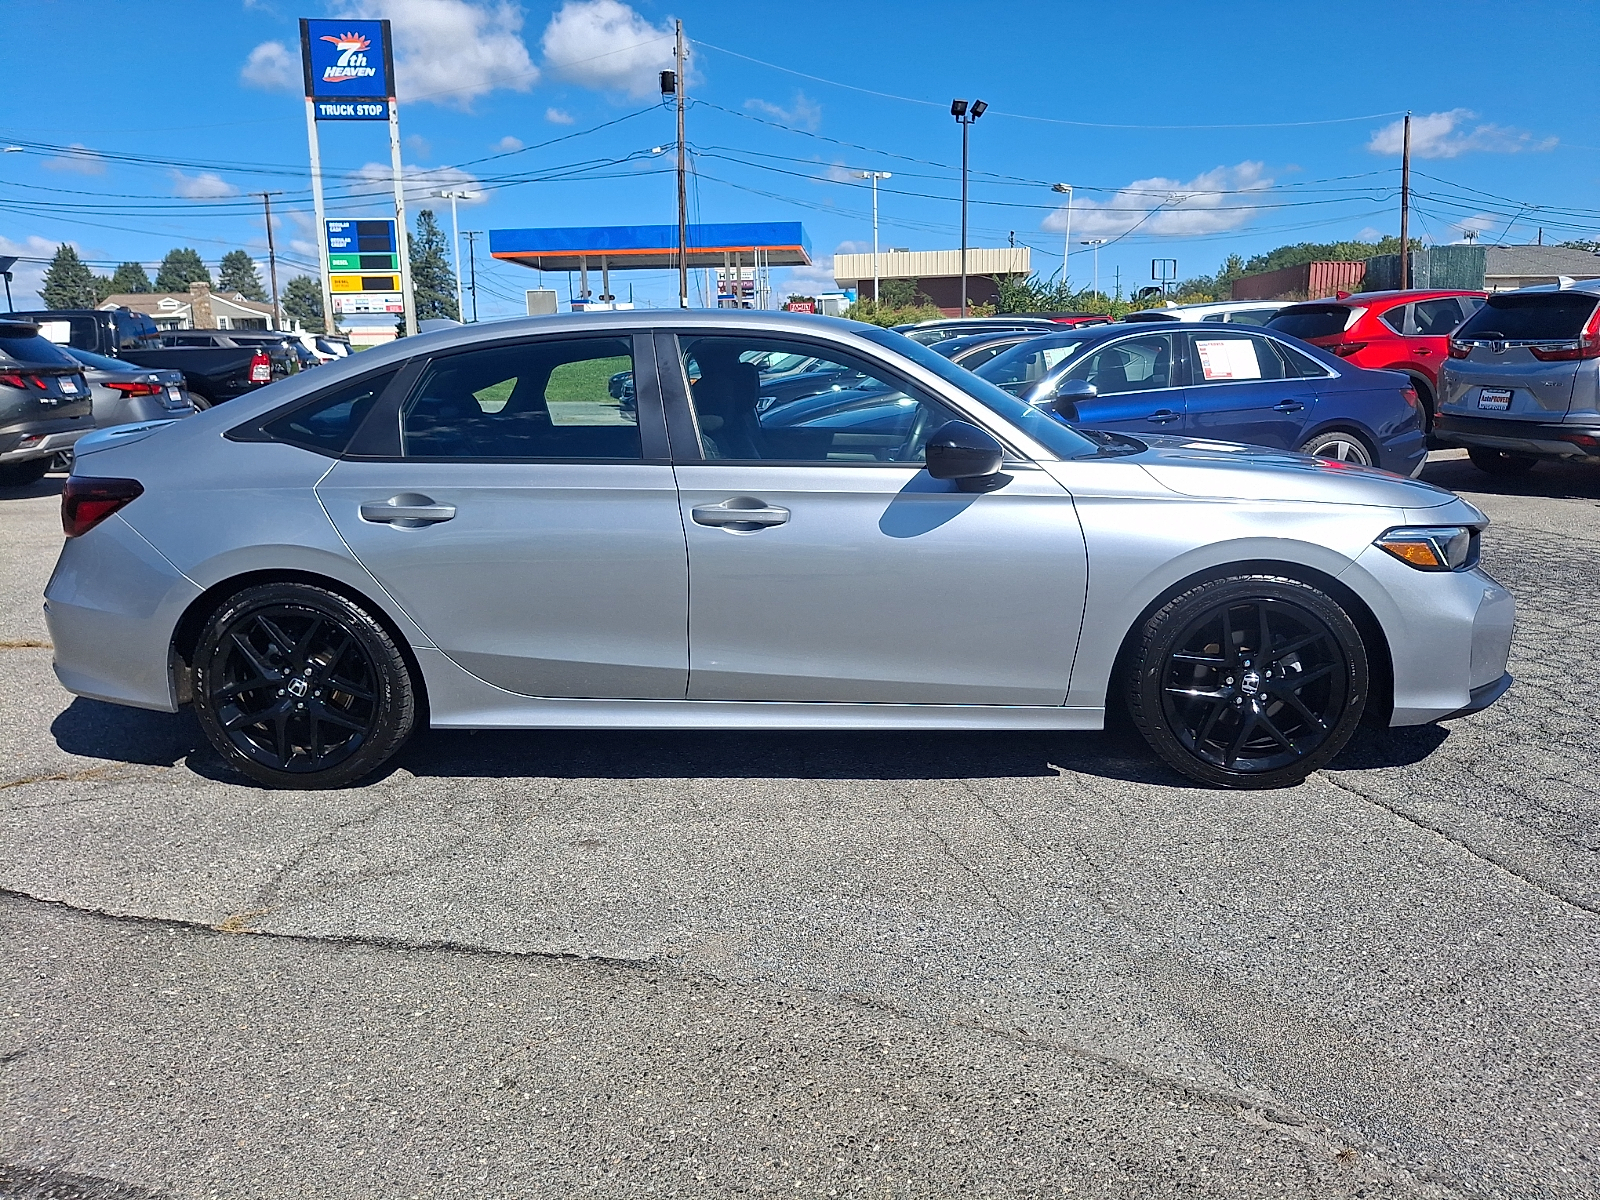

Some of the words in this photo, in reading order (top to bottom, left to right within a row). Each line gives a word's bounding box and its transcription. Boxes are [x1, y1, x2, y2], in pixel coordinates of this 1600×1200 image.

[337, 42, 367, 66] 7th
[323, 66, 376, 77] HEAVEN
[320, 105, 355, 116] TRUCK
[357, 105, 383, 116] STOP
